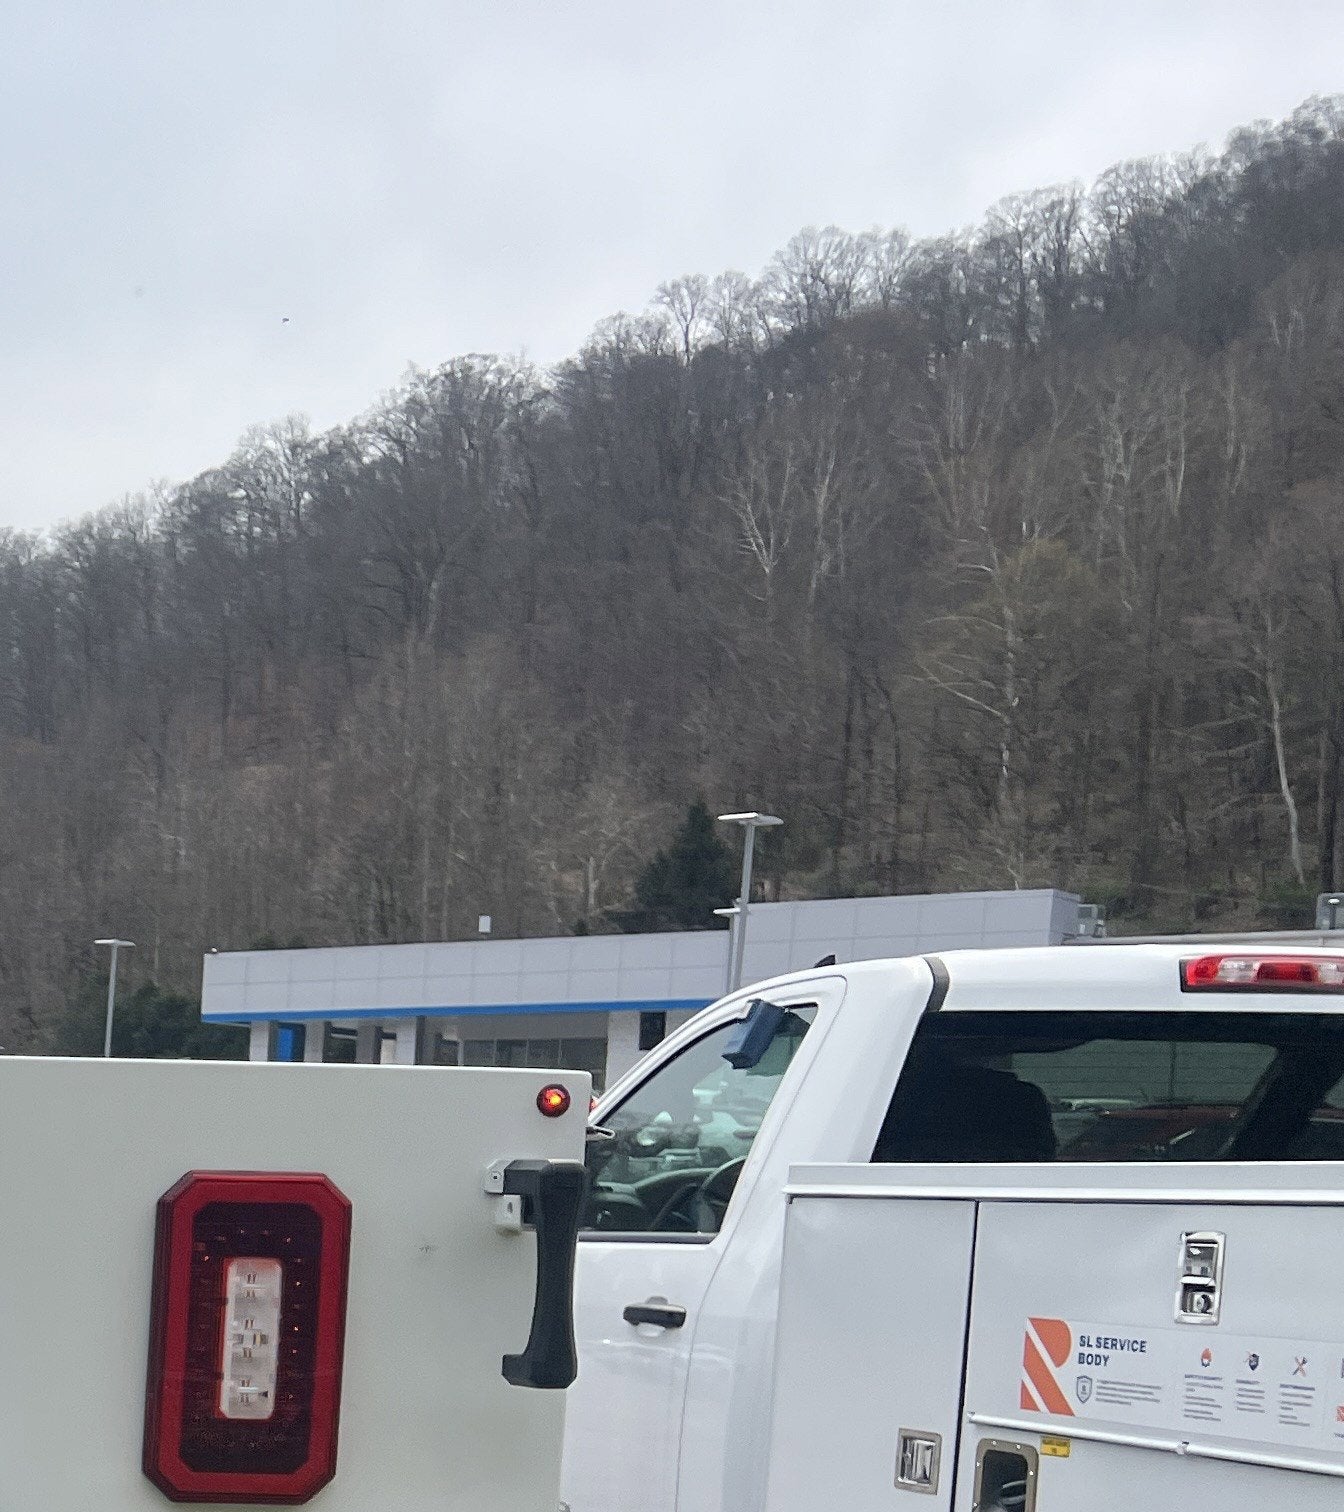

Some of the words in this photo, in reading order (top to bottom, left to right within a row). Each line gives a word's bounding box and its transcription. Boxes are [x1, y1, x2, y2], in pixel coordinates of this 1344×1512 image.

[1079, 1335, 1093, 1348] SL
[1095, 1336, 1148, 1353] SERVICE
[1078, 1352, 1110, 1367] BODY
